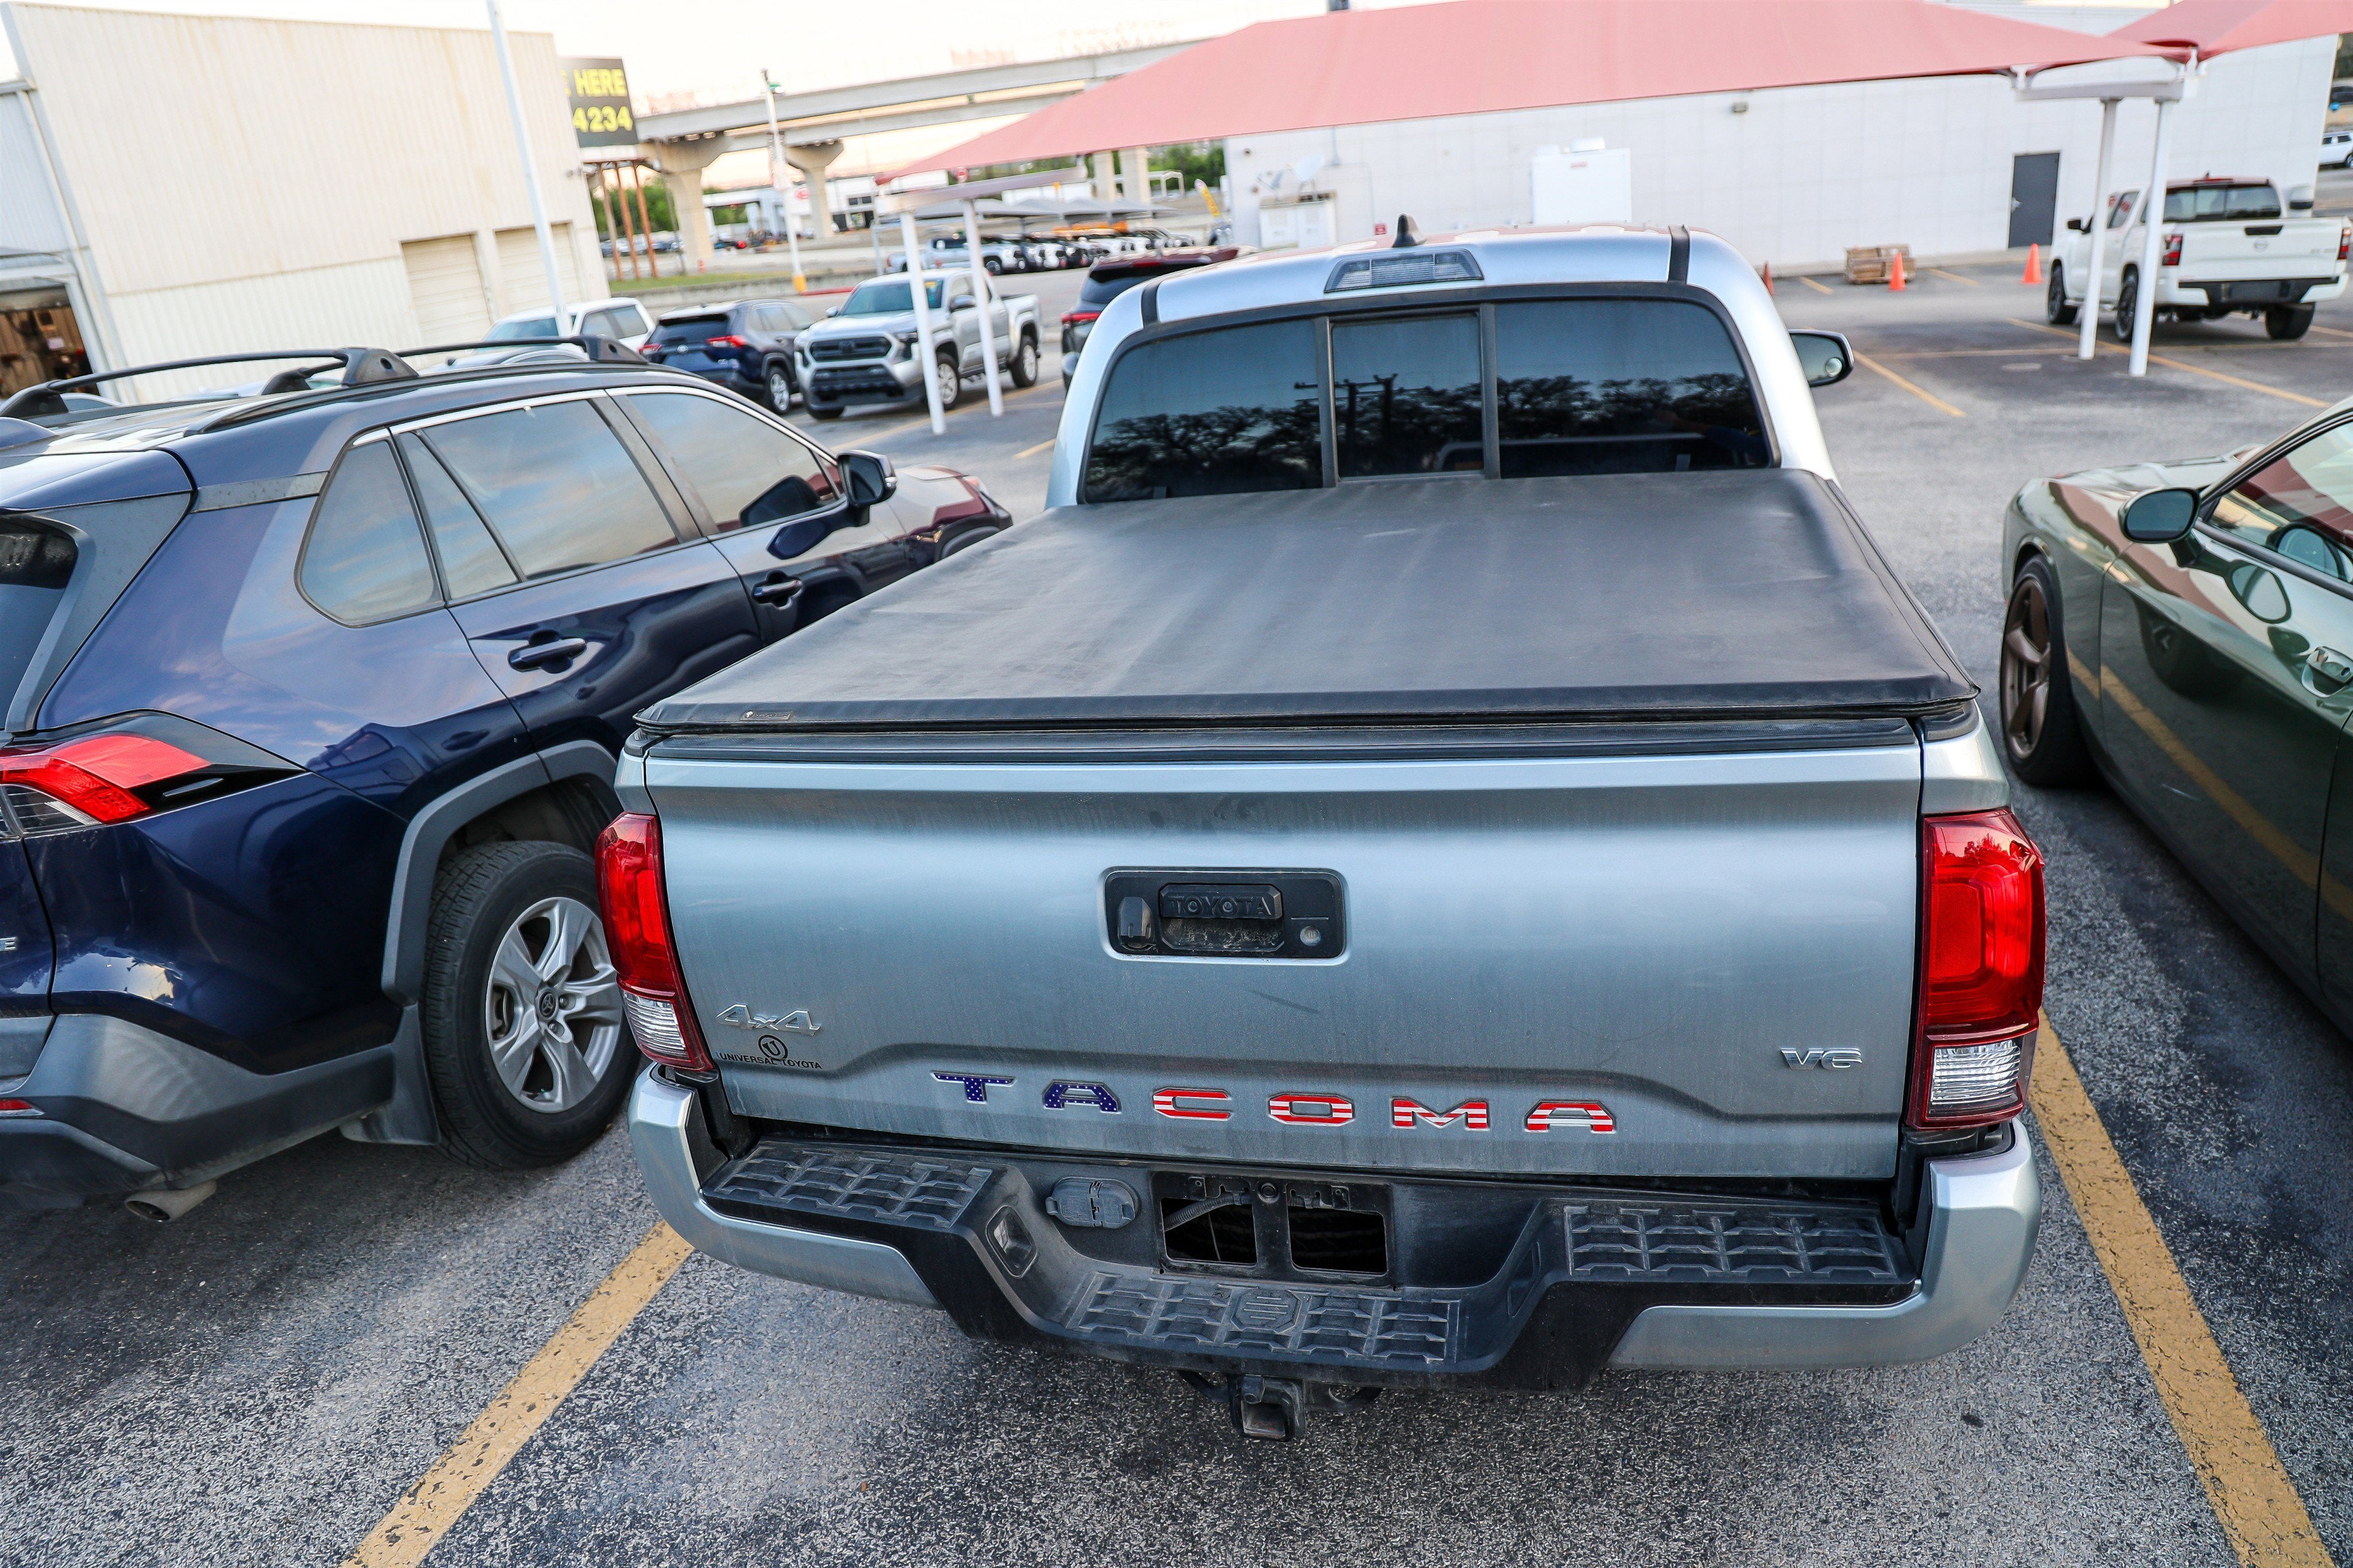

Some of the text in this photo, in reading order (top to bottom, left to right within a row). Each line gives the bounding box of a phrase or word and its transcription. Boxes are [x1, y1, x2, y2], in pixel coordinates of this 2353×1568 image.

[573, 68, 628, 97] HERE
[572, 105, 633, 133] 4234
[1168, 895, 1273, 917] TOYOTA
[715, 1003, 820, 1036] 4x4
[719, 1052, 823, 1069] UNIVERSAL TOYOTA
[1780, 1048, 1862, 1070] V6
[931, 1070, 1617, 1134] TACOMA
